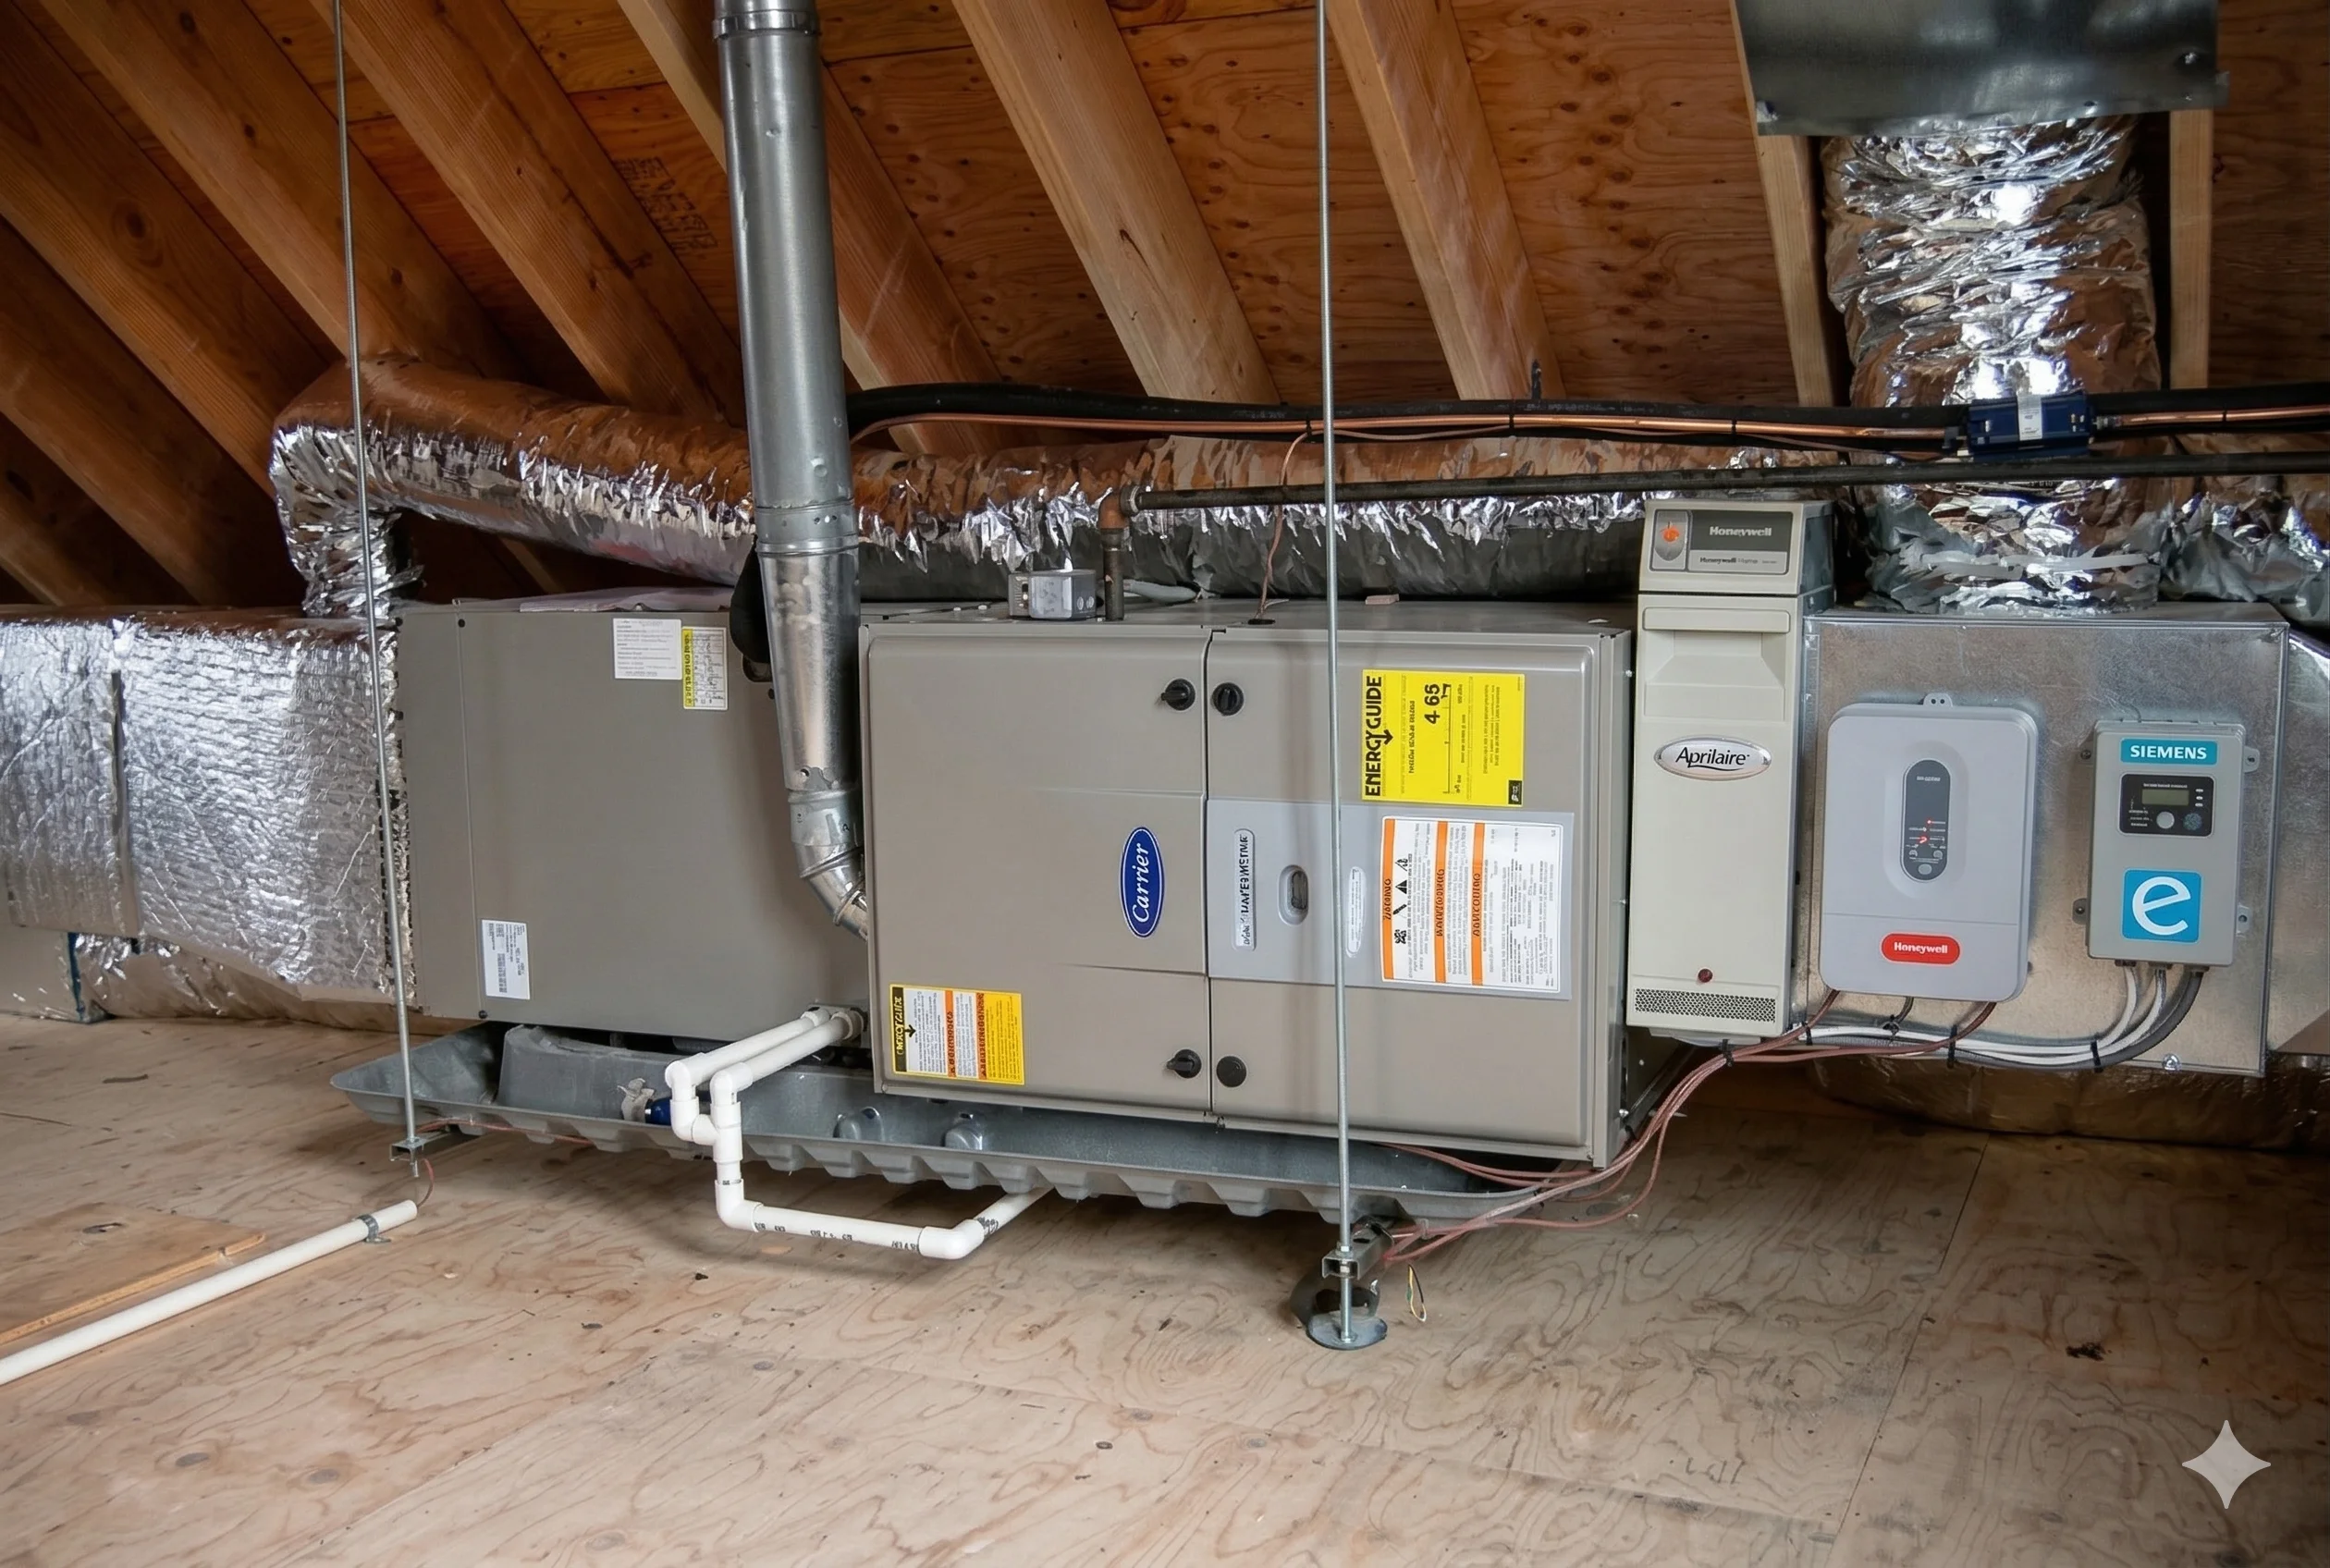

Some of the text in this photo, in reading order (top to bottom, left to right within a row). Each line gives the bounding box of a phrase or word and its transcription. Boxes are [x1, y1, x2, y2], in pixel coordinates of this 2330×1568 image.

[1710, 526, 1772, 537] Honeywell
[1675, 746, 1747, 769] Aprilaire
[2130, 745, 2207, 759] SIEMENS
[1132, 843, 1149, 923] Carrier
[1895, 942, 1948, 955] Honeywell
